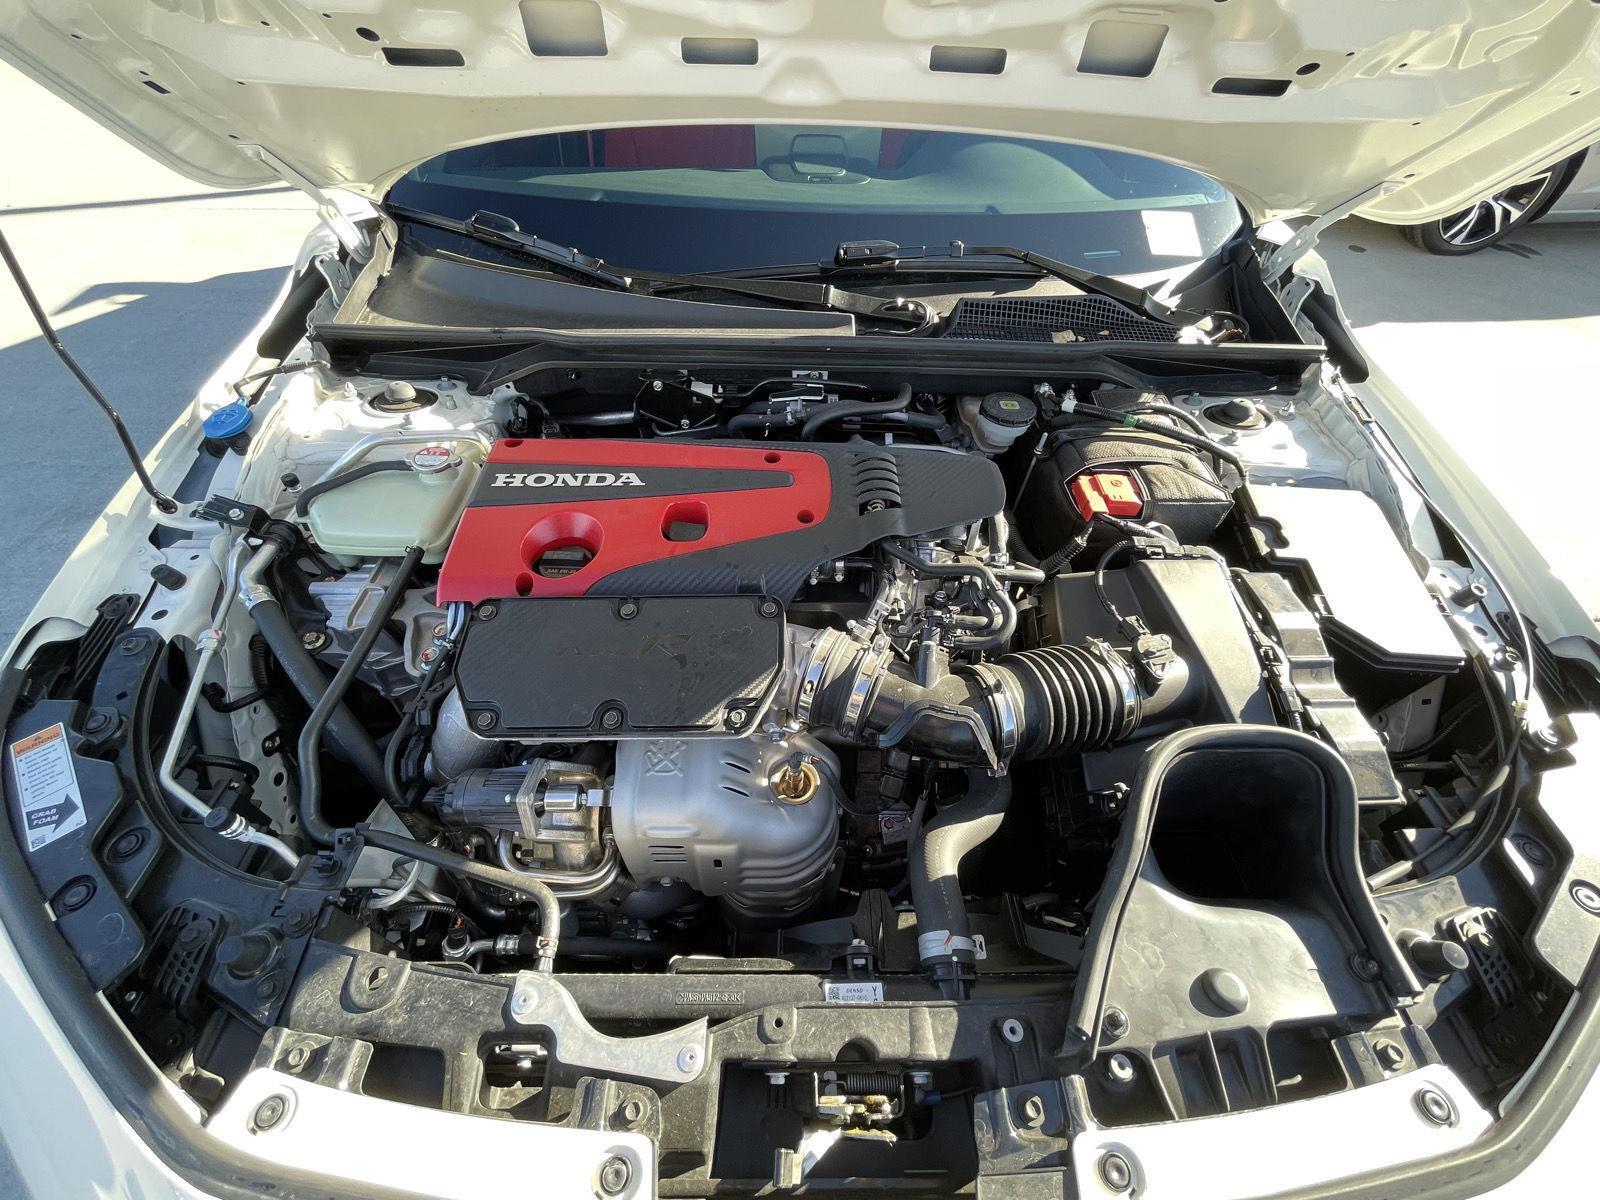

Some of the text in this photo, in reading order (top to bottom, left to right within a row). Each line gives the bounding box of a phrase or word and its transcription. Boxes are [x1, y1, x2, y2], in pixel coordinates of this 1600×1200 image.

[491, 472, 645, 487] HONDA
[16, 732, 60, 755] WARNING
[31, 808, 57, 819] GRAB
[33, 814, 59, 826] FOAM
[871, 985, 877, 997] Y
